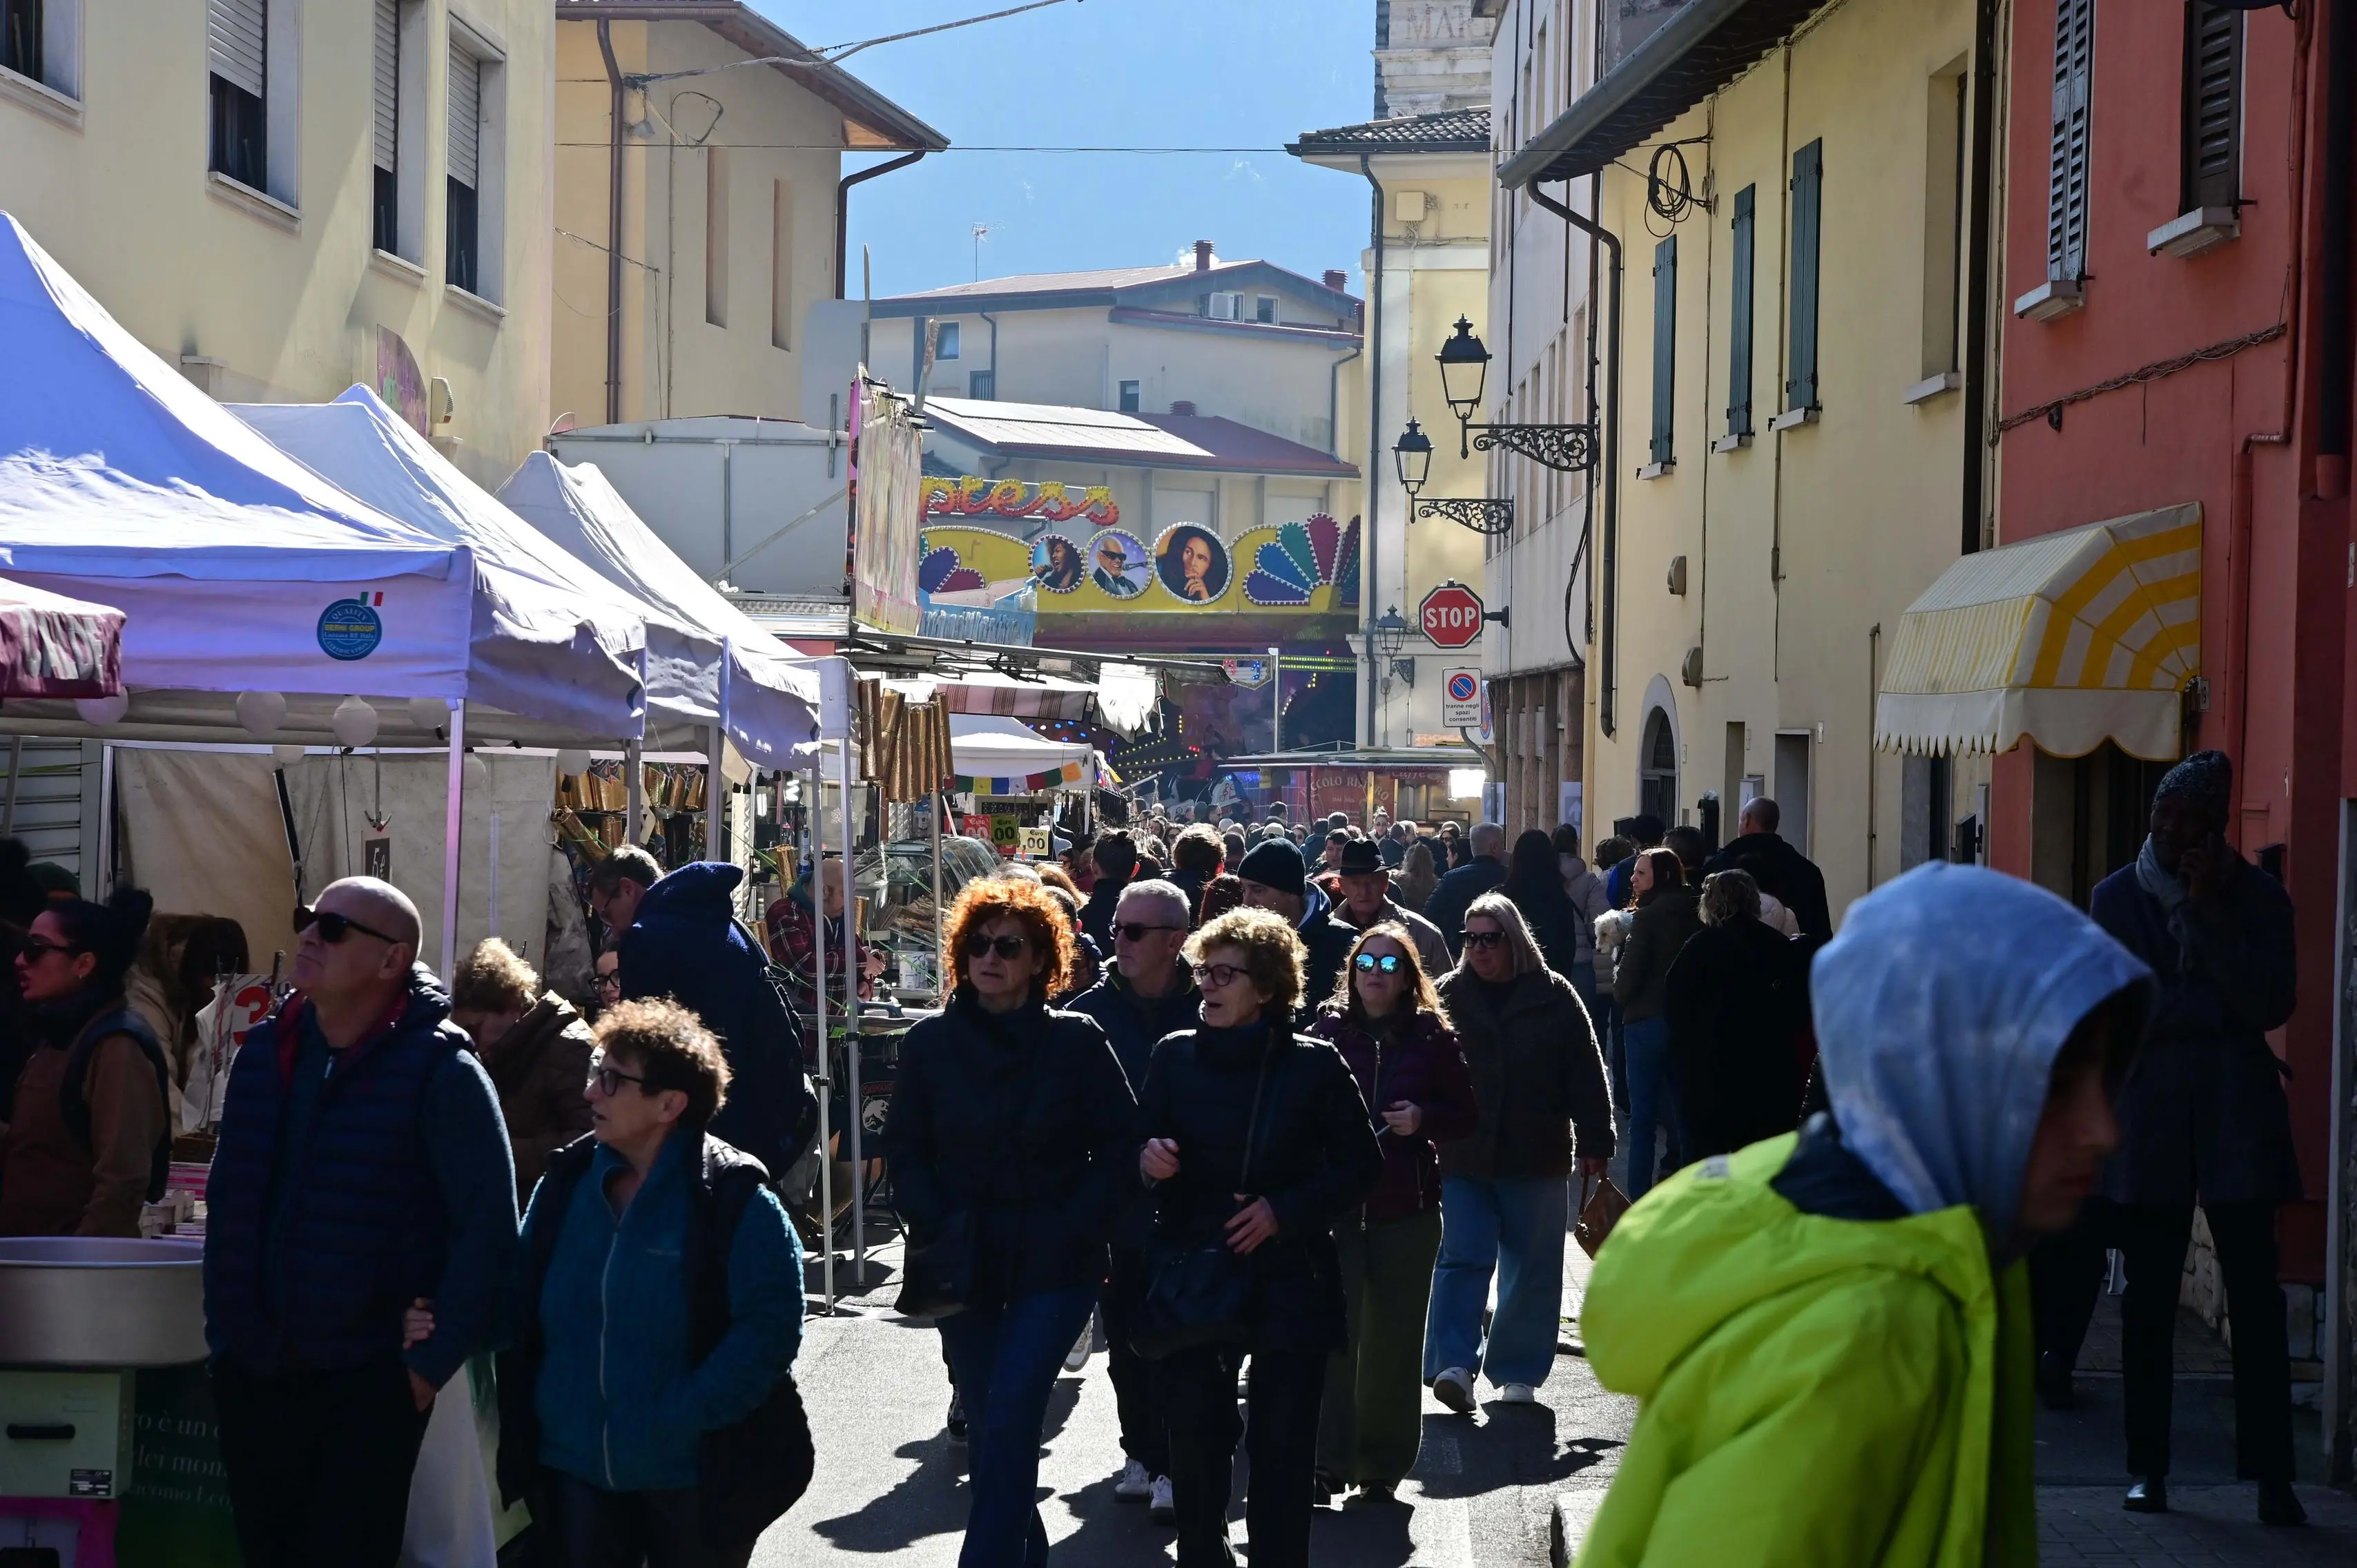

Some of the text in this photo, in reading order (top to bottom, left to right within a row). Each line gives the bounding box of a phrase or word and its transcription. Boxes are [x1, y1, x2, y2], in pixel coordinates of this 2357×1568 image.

[331, 608, 368, 621] QUALITY
[1426, 607, 1477, 628] STOP
[178, 1419, 207, 1437] un
[196, 1484, 234, 1515] Leo
